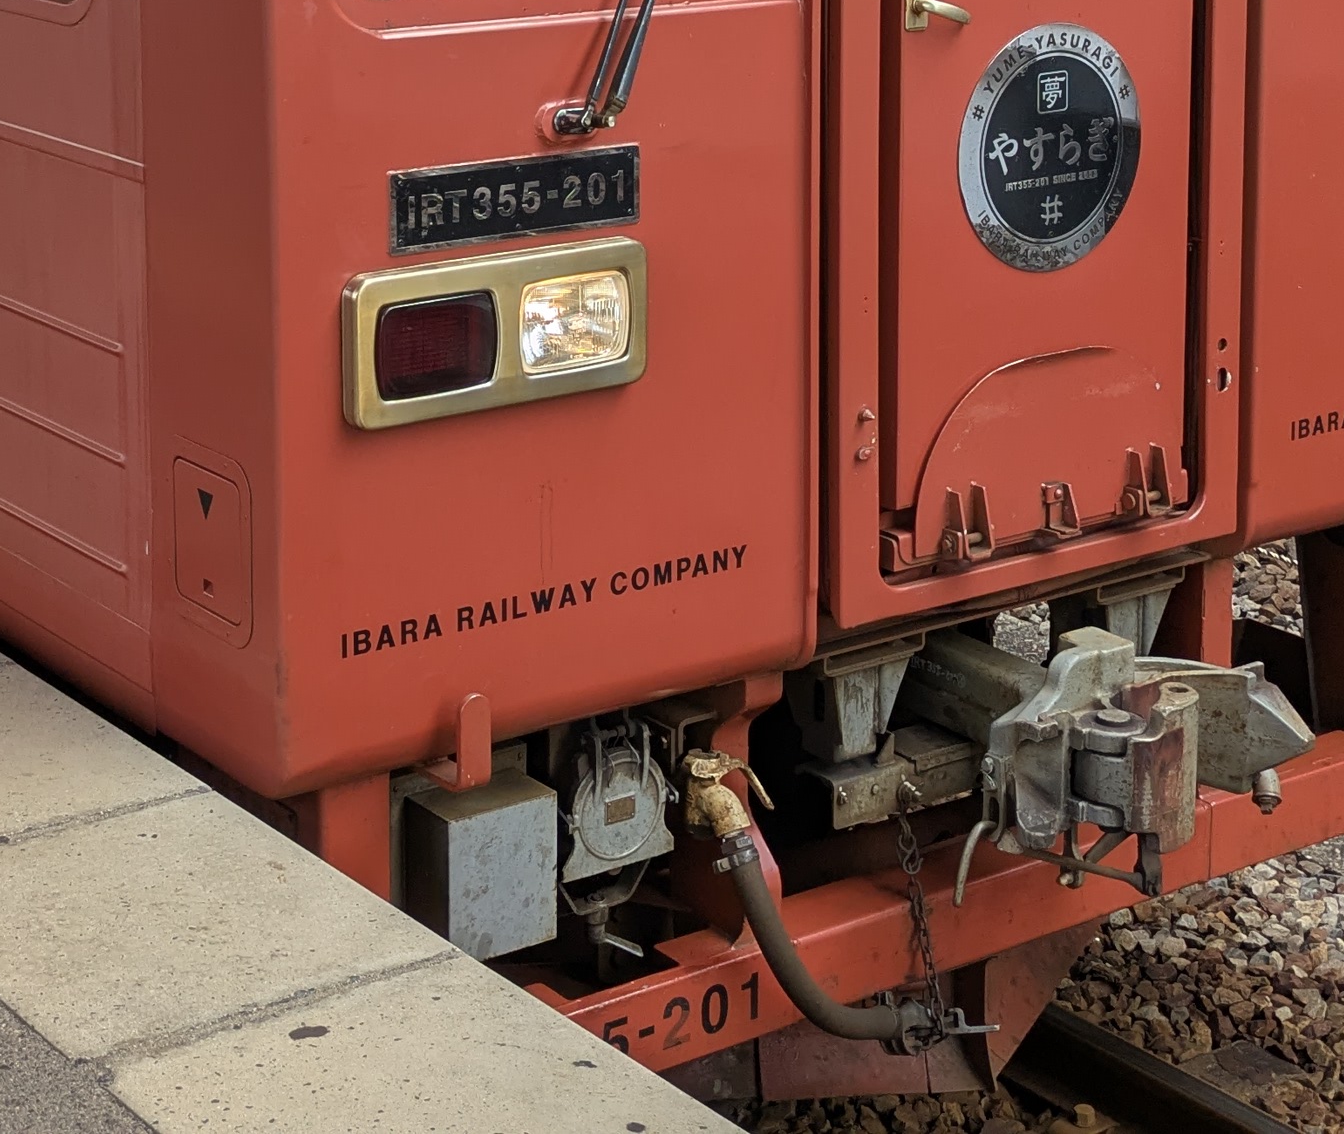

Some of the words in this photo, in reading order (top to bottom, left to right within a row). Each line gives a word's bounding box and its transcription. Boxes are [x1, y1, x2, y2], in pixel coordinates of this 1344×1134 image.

[983, 32, 1121, 95] YUME-YASURAGI
[1040, 76, 1066, 109] 夢
[988, 117, 1116, 175] やすらぎ
[407, 169, 627, 229] IRT355-201
[1053, 172, 1076, 185] SINCE
[342, 613, 442, 659] IBARA
[458, 580, 595, 630] RAILWAY
[610, 545, 747, 594] COMPANY
